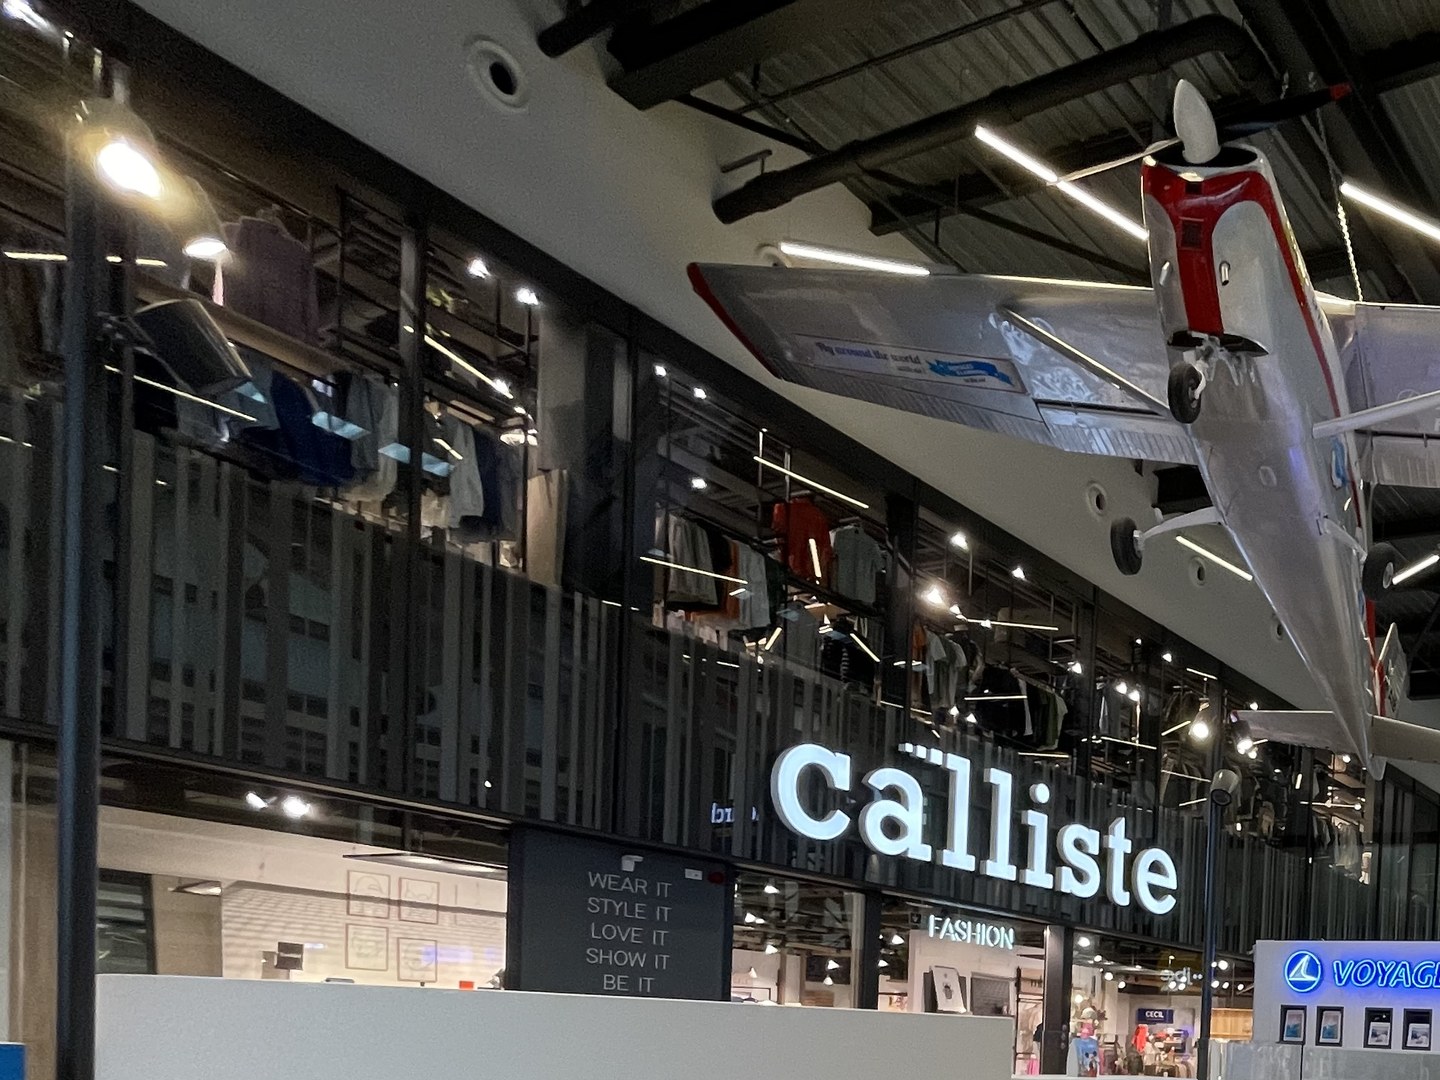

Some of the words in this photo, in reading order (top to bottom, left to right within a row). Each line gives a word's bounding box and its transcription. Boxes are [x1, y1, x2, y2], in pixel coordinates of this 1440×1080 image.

[588, 871, 648, 895] WEAR
[656, 882, 672, 898] IT
[587, 897, 647, 920] STYLE
[656, 906, 672, 922] IT
[591, 922, 643, 944] LOVE
[653, 930, 669, 946] IT
[928, 914, 1015, 950] FASHION
[586, 948, 646, 968] SHOW
[655, 954, 670, 970] IT
[603, 974, 629, 992] BE
[639, 977, 655, 993] IT
[1145, 1010, 1165, 1019] CECIL
